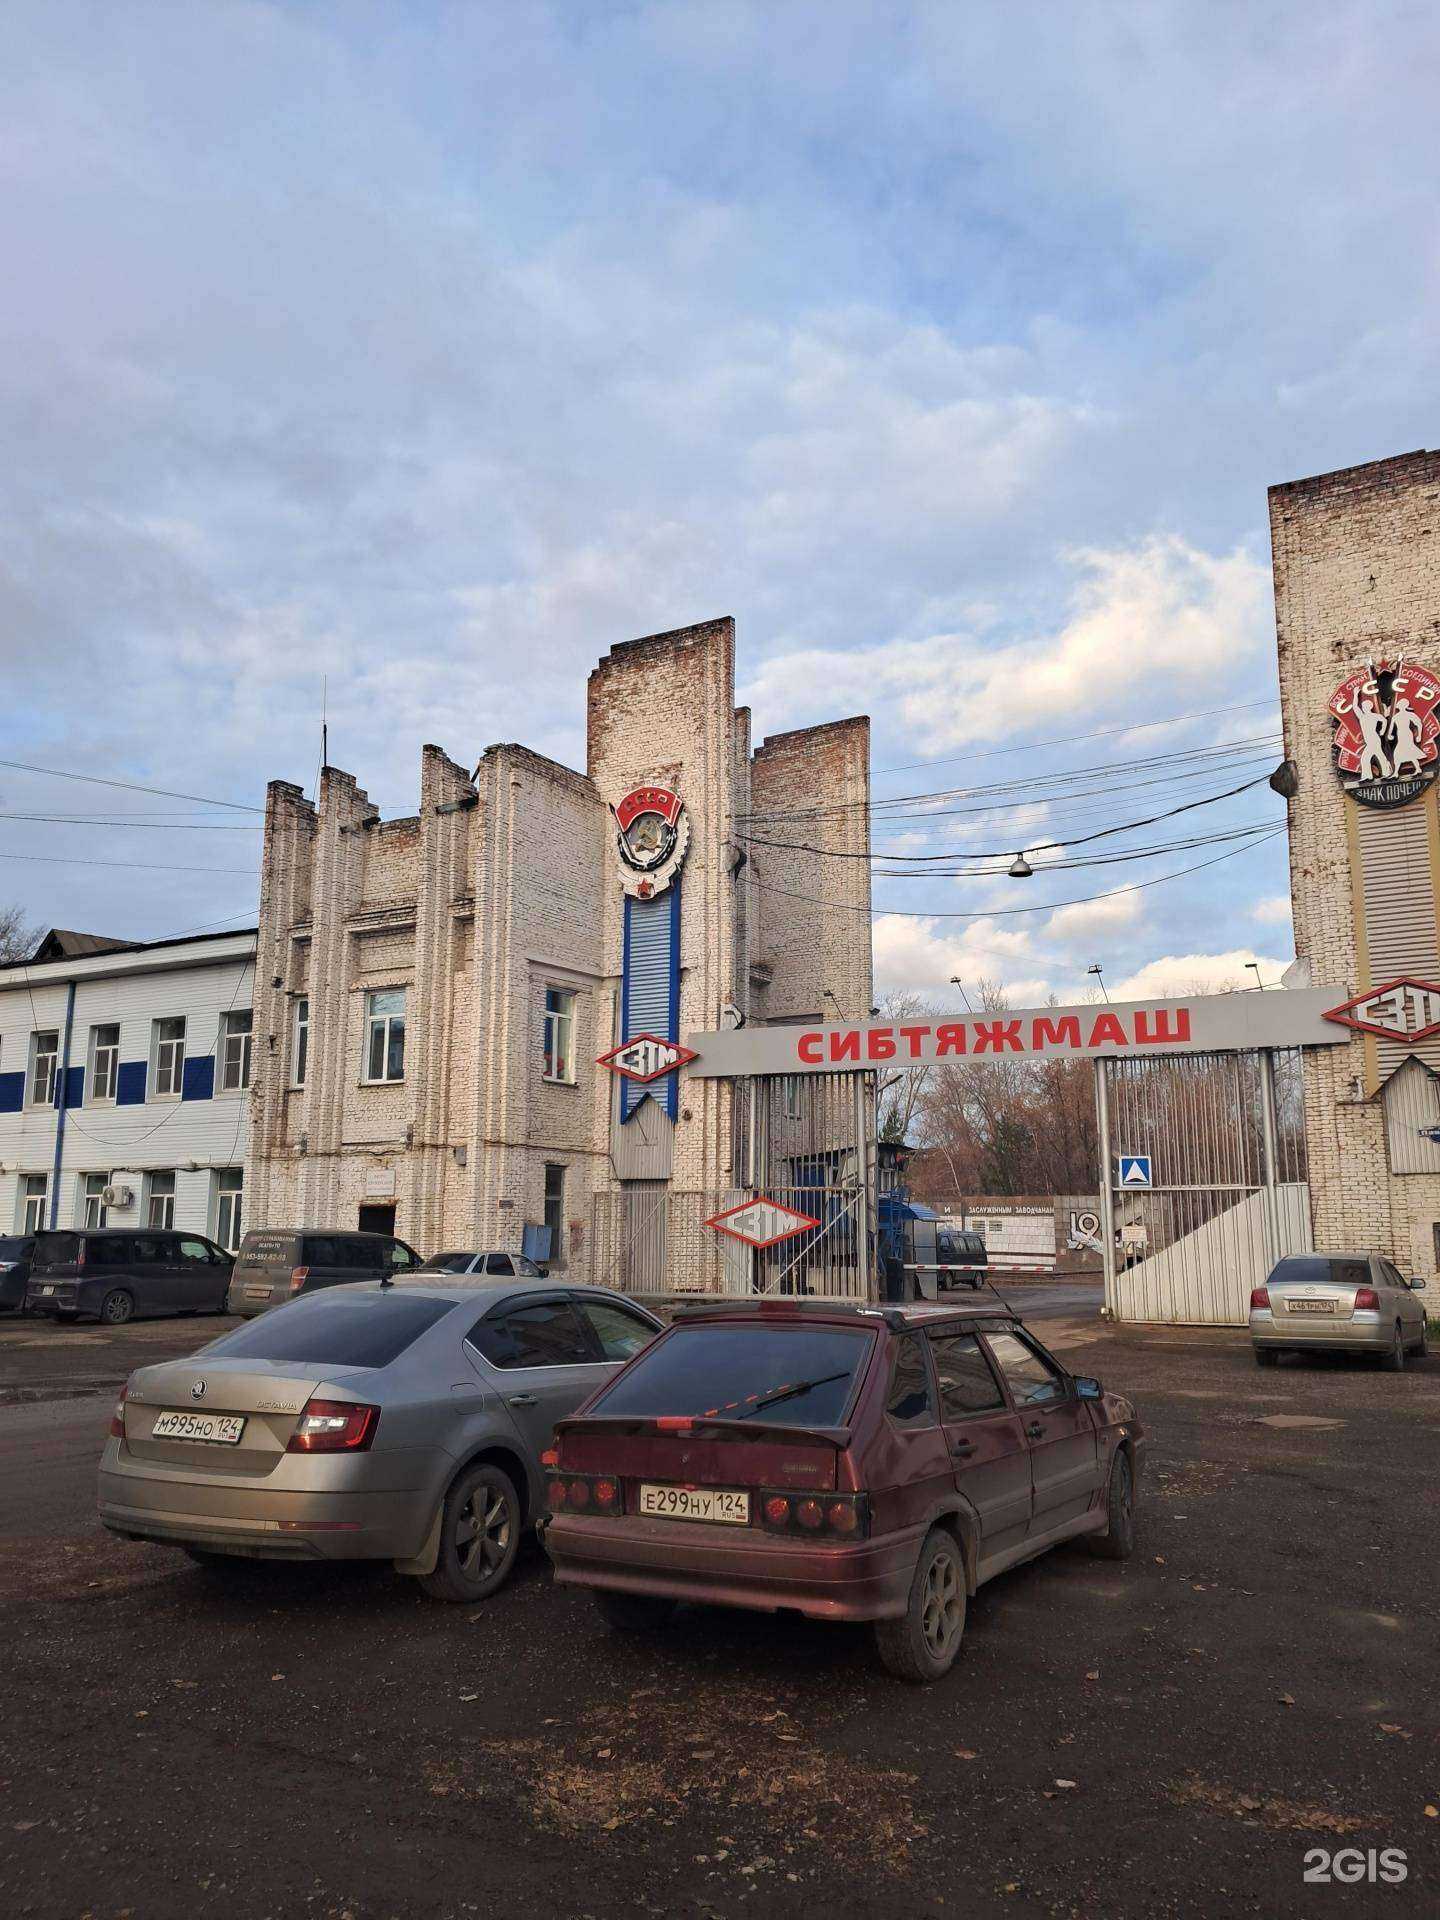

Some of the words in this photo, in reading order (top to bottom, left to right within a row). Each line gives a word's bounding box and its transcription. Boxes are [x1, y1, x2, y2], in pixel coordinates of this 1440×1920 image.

[797, 1007, 1191, 1063] СИБТЯЖМАШ
[157, 1415, 213, 1436] М995НО
[217, 1418, 238, 1433] 124
[646, 1490, 711, 1515] Е299НУ
[716, 1494, 743, 1512] 124
